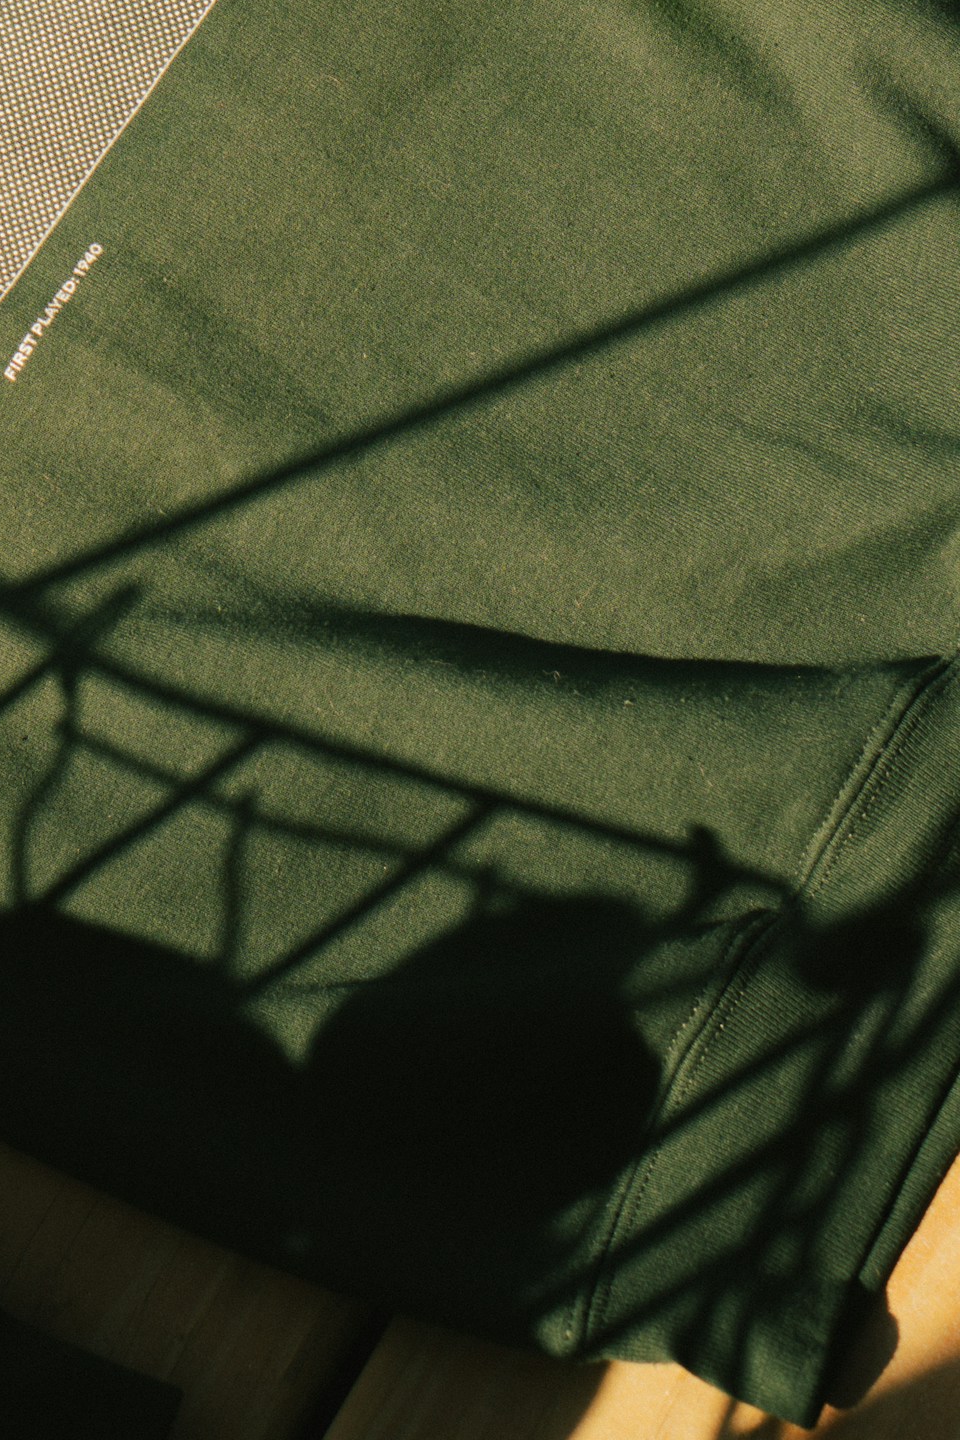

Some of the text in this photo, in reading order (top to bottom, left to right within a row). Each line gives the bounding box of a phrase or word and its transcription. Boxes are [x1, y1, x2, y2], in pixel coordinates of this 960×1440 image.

[3, 242, 104, 383] FIRST PLAYED: 1940
